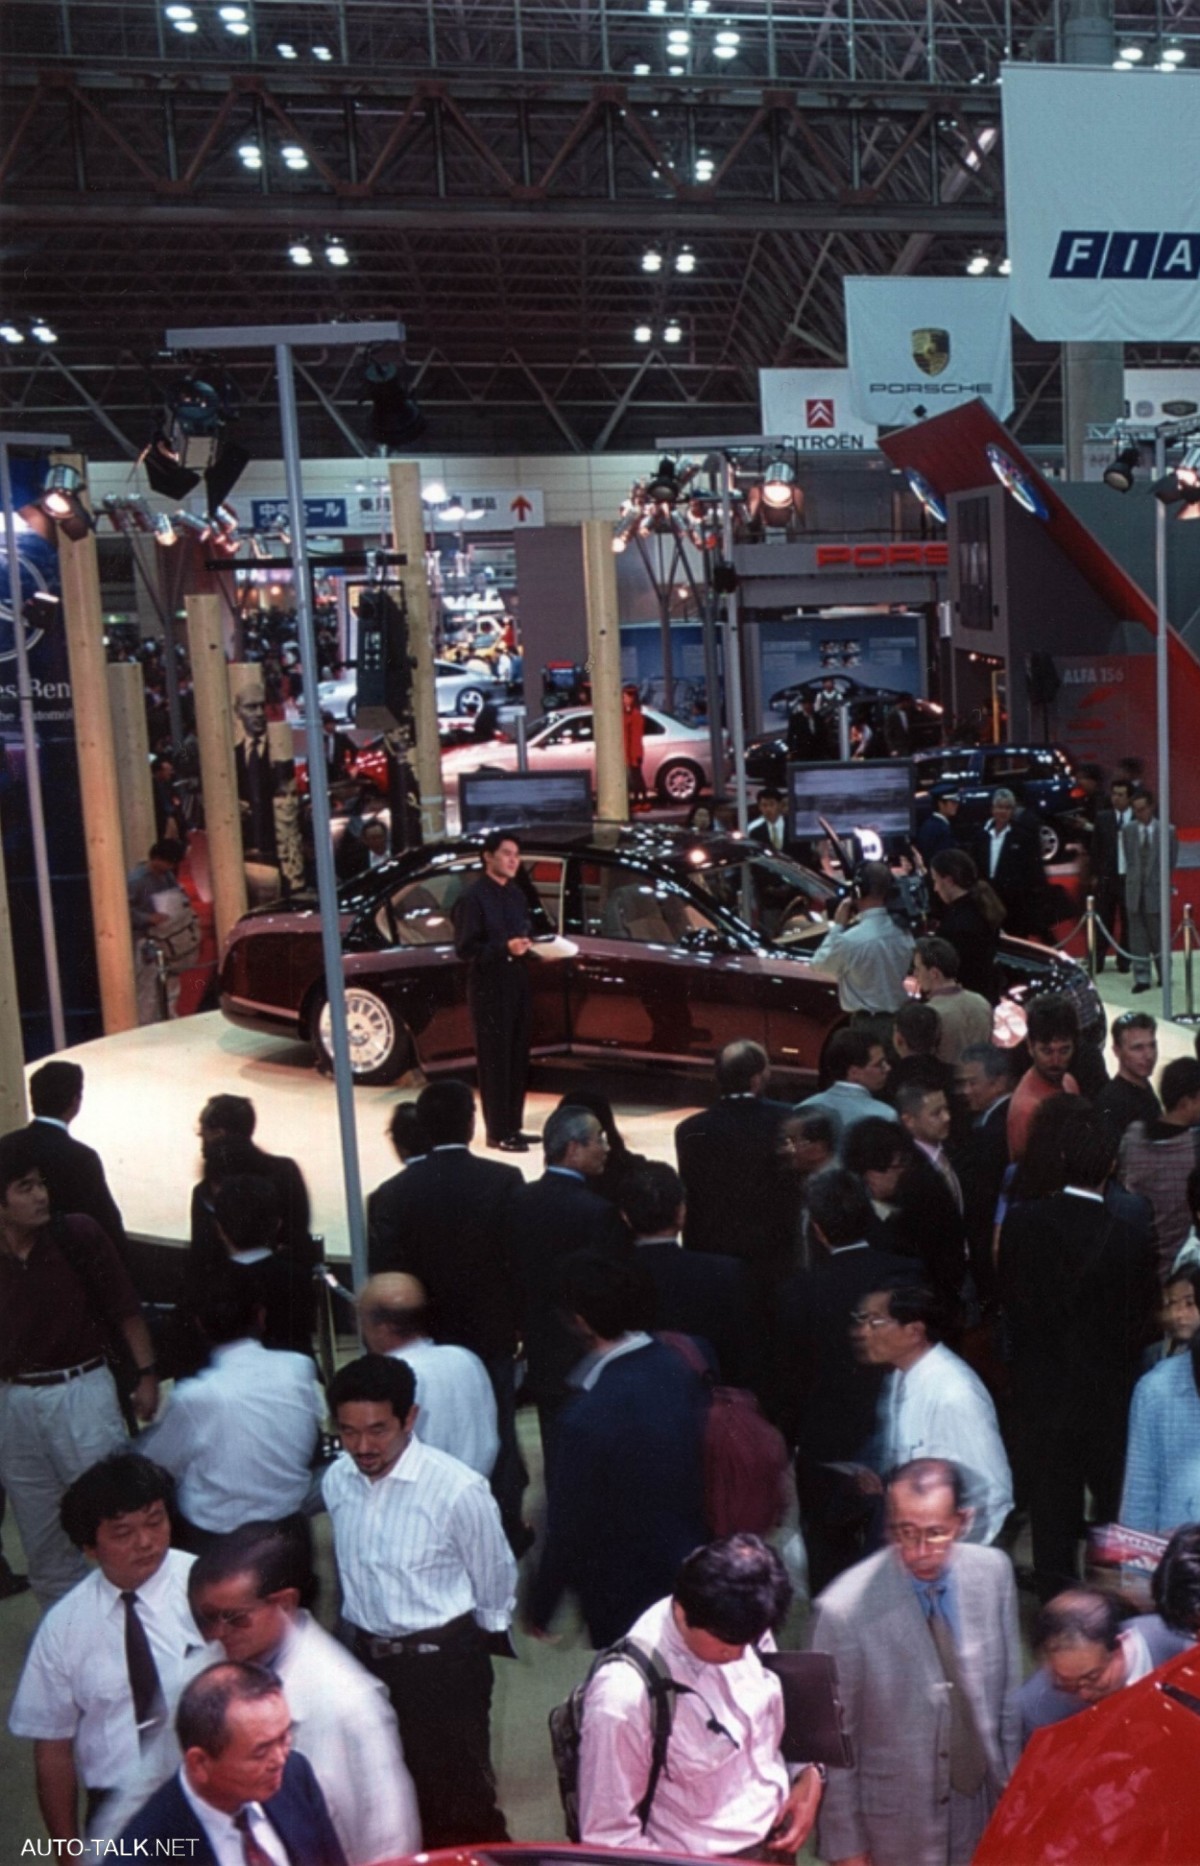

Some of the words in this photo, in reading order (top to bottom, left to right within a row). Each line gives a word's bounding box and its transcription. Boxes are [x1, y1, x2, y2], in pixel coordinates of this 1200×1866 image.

[869, 382, 993, 394] PORSCHE
[782, 432, 864, 449] CITROËN
[816, 543, 948, 567] PORS
[1063, 668, 1097, 684] ALFA
[1101, 667, 1125, 682] 156
